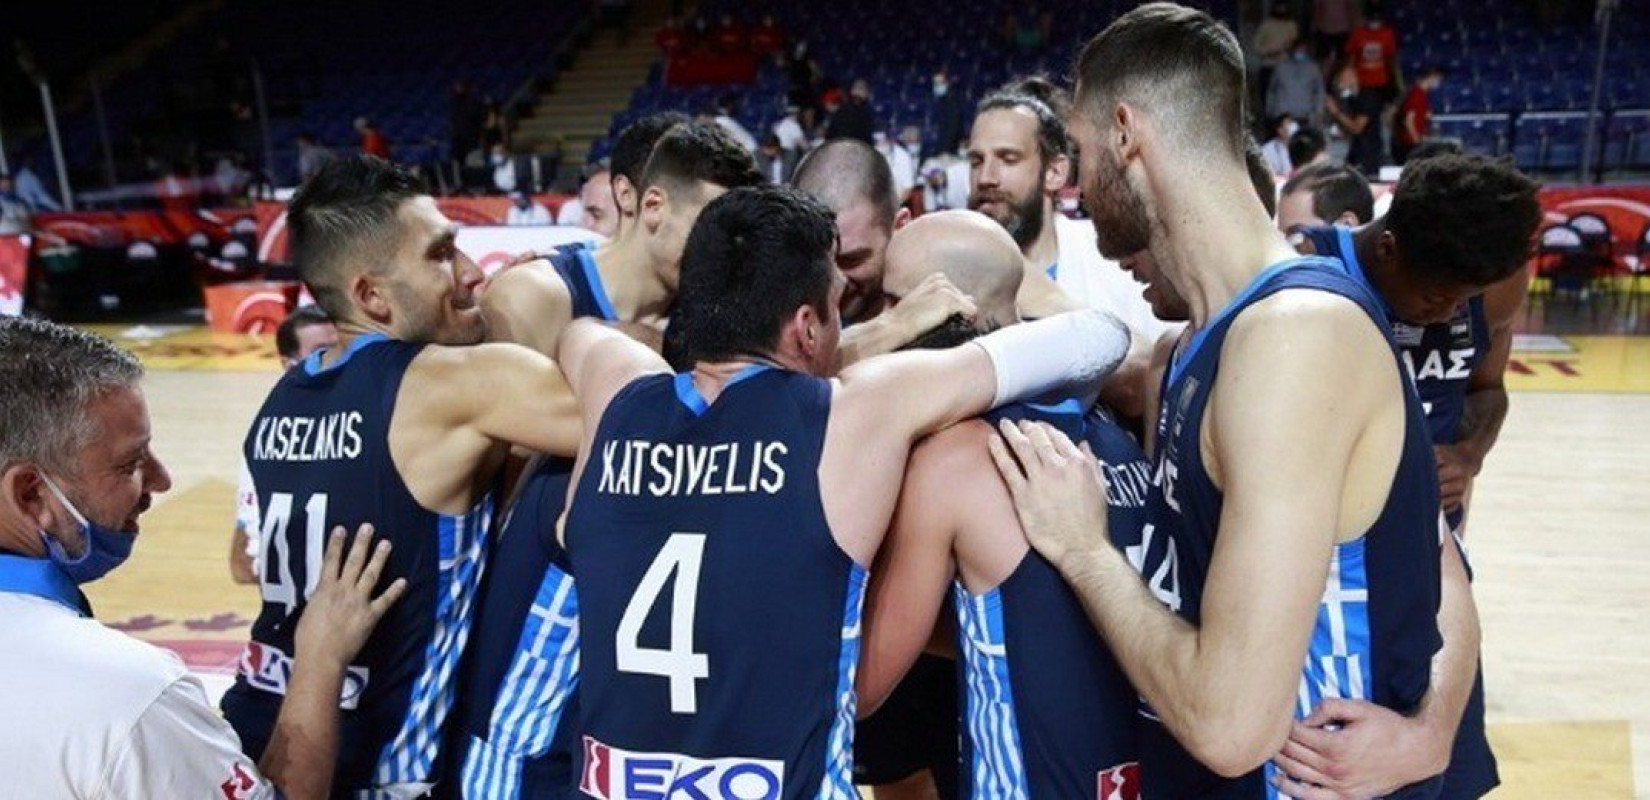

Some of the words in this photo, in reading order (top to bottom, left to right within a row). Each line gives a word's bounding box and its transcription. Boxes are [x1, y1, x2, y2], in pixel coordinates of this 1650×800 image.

[598, 440, 788, 496] KATSIVELIS
[260, 493, 328, 617] 41
[616, 532, 709, 714] 4
[625, 757, 780, 800] EKO
